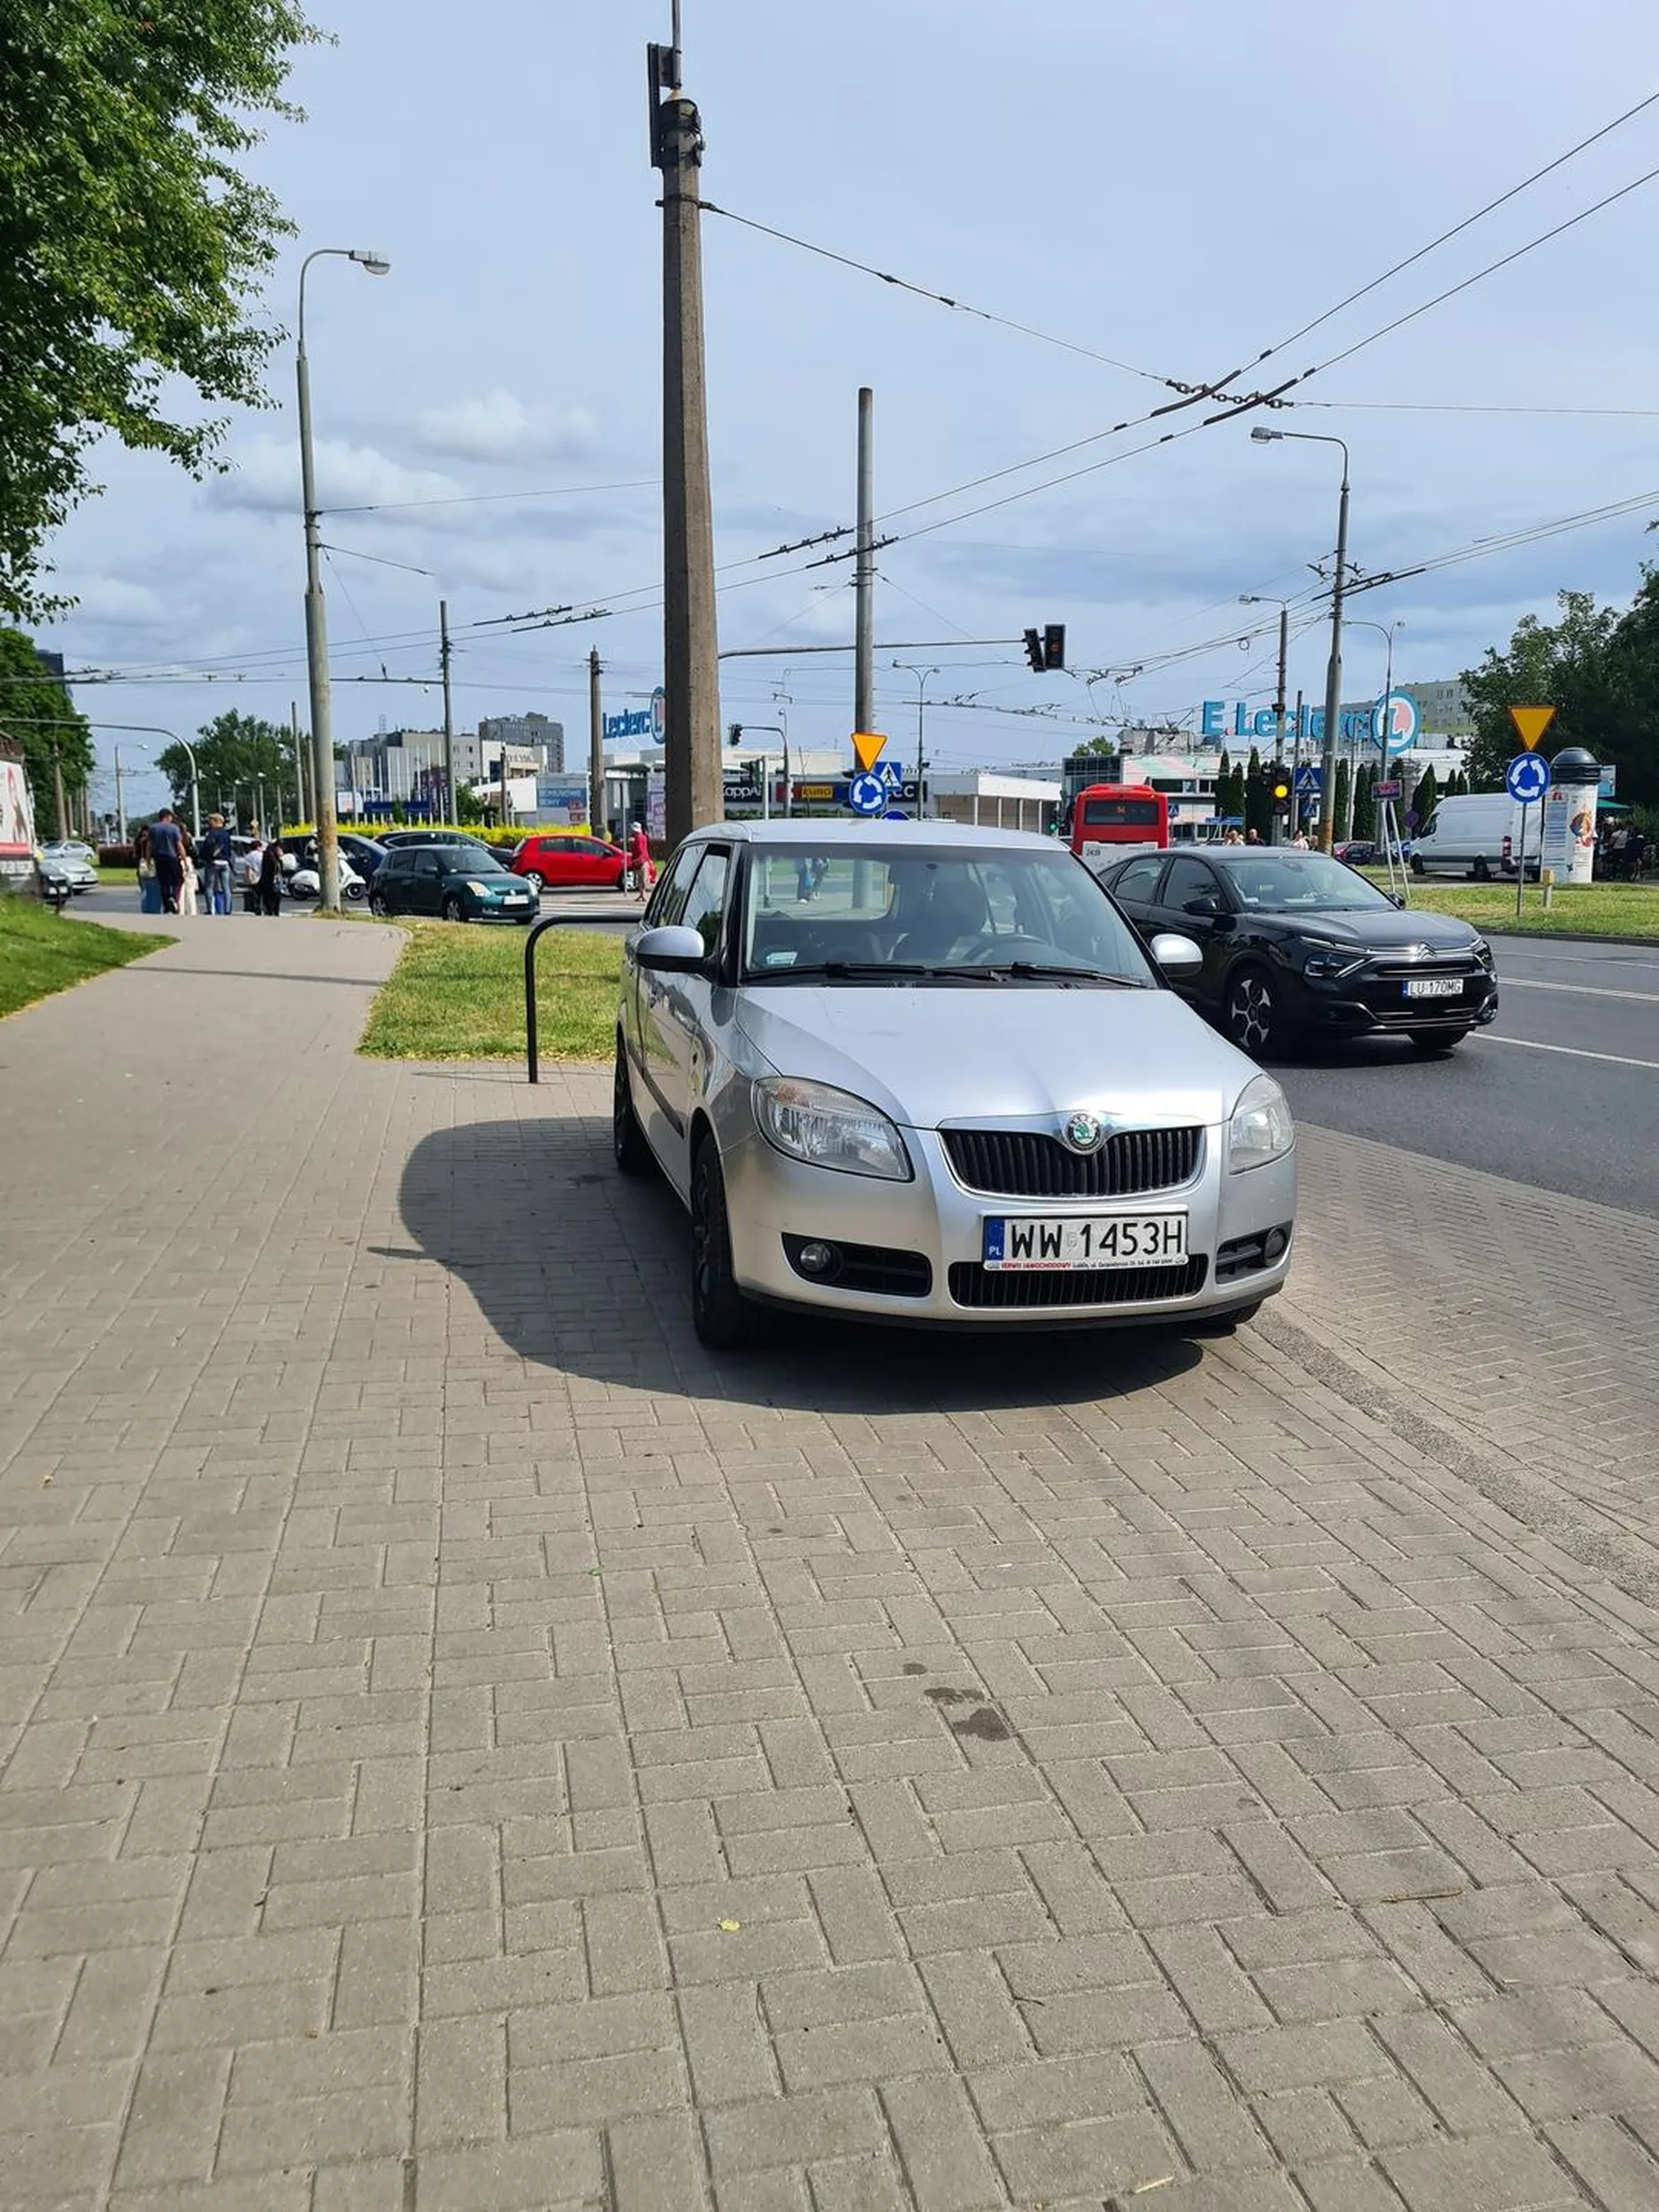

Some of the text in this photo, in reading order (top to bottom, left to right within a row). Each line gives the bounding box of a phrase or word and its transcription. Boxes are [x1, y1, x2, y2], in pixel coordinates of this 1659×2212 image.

[1202, 700, 1369, 739] E.Leclec
[887, 785, 915, 798] CC
[1011, 1217, 1182, 1258] WW 1453H
[988, 1246, 1002, 1256] PL
